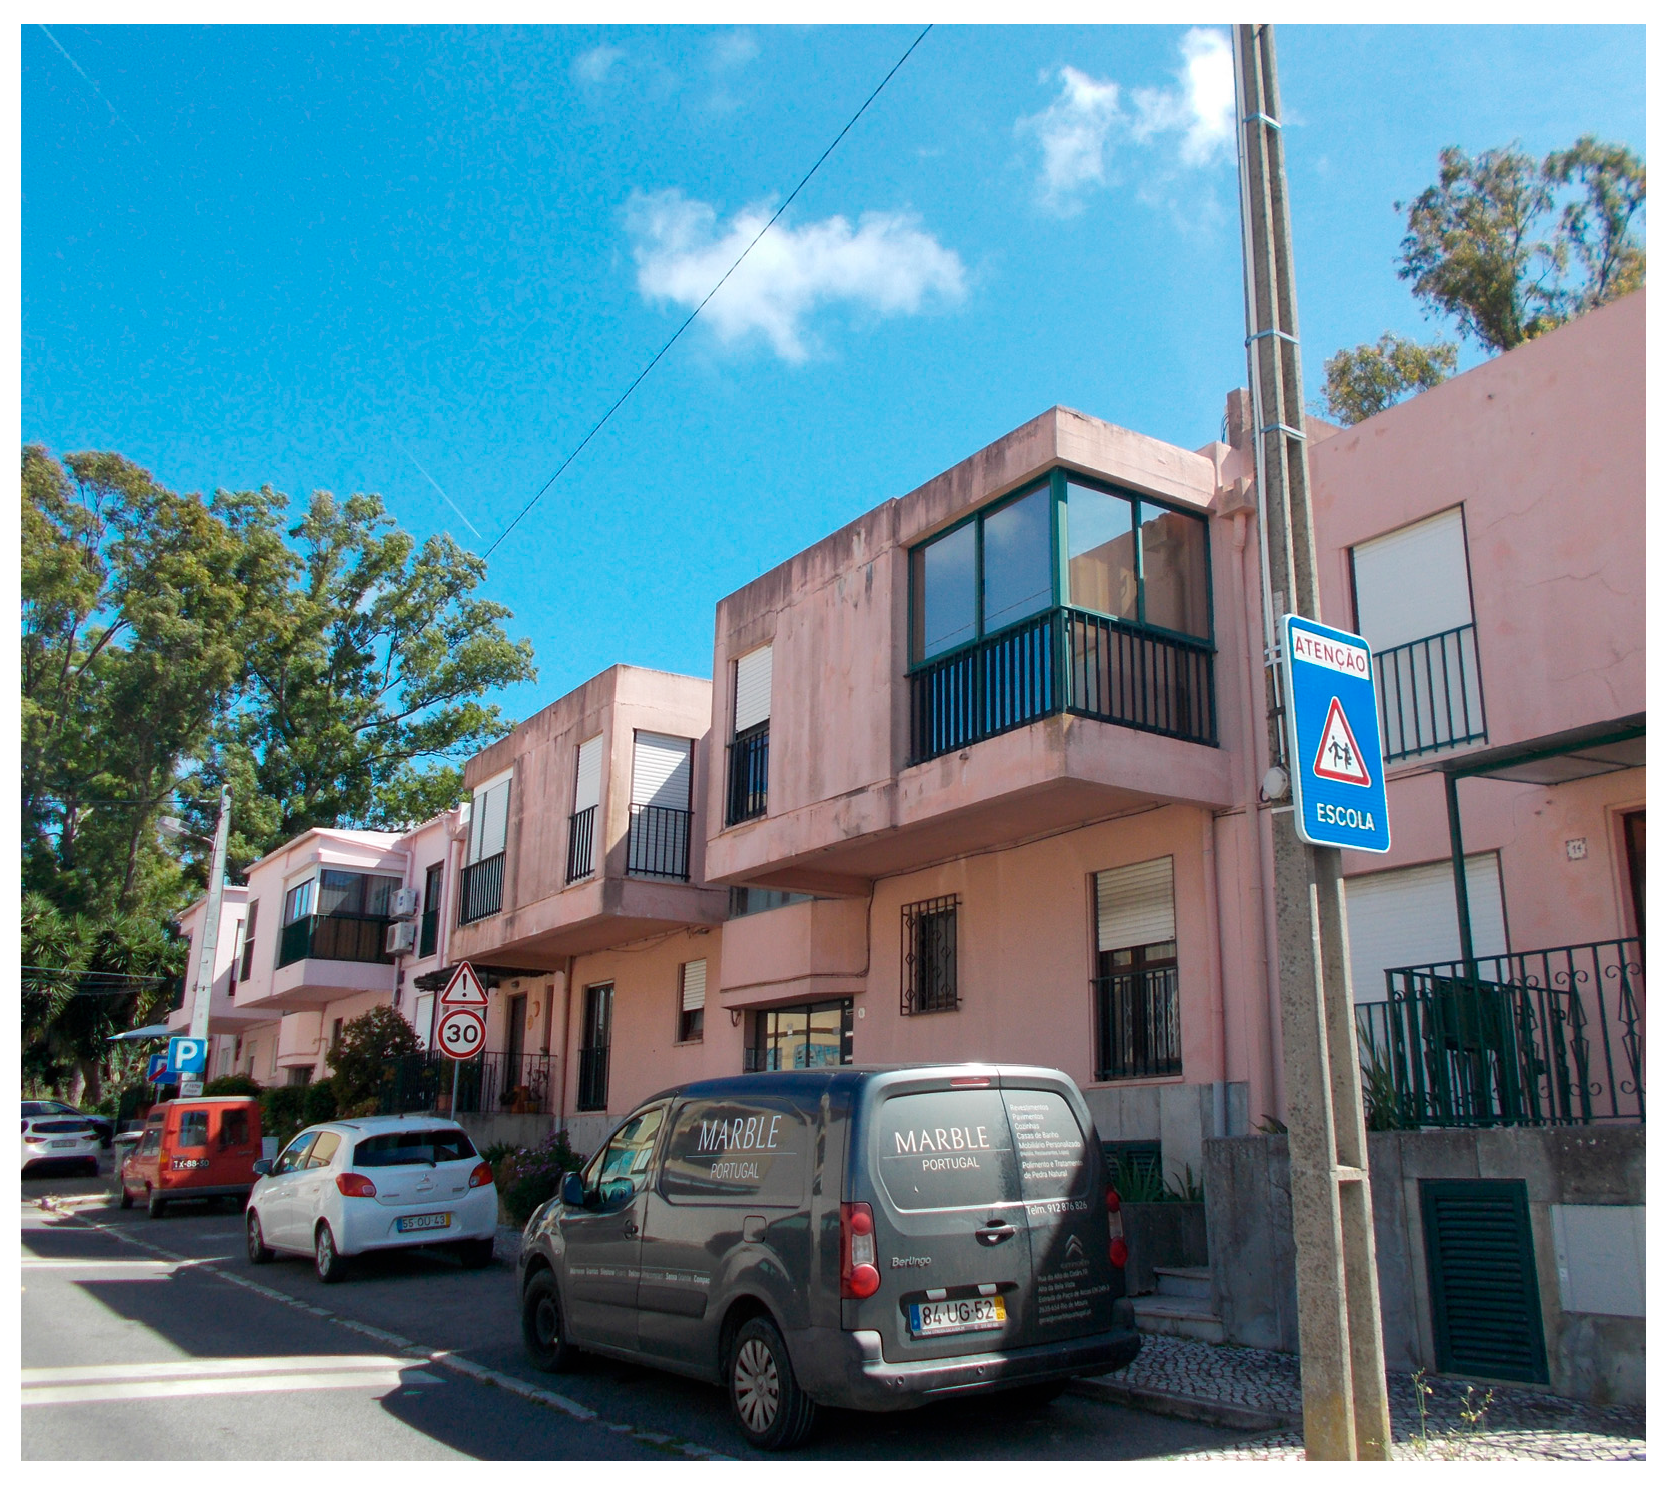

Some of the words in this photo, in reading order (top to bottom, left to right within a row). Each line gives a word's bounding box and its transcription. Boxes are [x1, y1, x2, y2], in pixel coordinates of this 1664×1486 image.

[1295, 635, 1367, 674] ATENÇÃO
[1316, 802, 1376, 832] ESCOLA
[446, 1024, 478, 1043] 30
[175, 1041, 198, 1069] P
[697, 1115, 782, 1151] MARBLE
[895, 1126, 990, 1153] MARBLE
[1045, 1140, 1081, 1148] Personalizado
[710, 1162, 759, 1179] PORTUGAL
[922, 1157, 980, 1171] PORTUGAL
[1022, 1161, 1050, 1169] Polimento
[1024, 1171, 1031, 1179] de
[1047, 1202, 1061, 1213] 912
[1061, 1201, 1075, 1212] 876
[1075, 1200, 1088, 1210] 826
[891, 1256, 932, 1269] Berlingo
